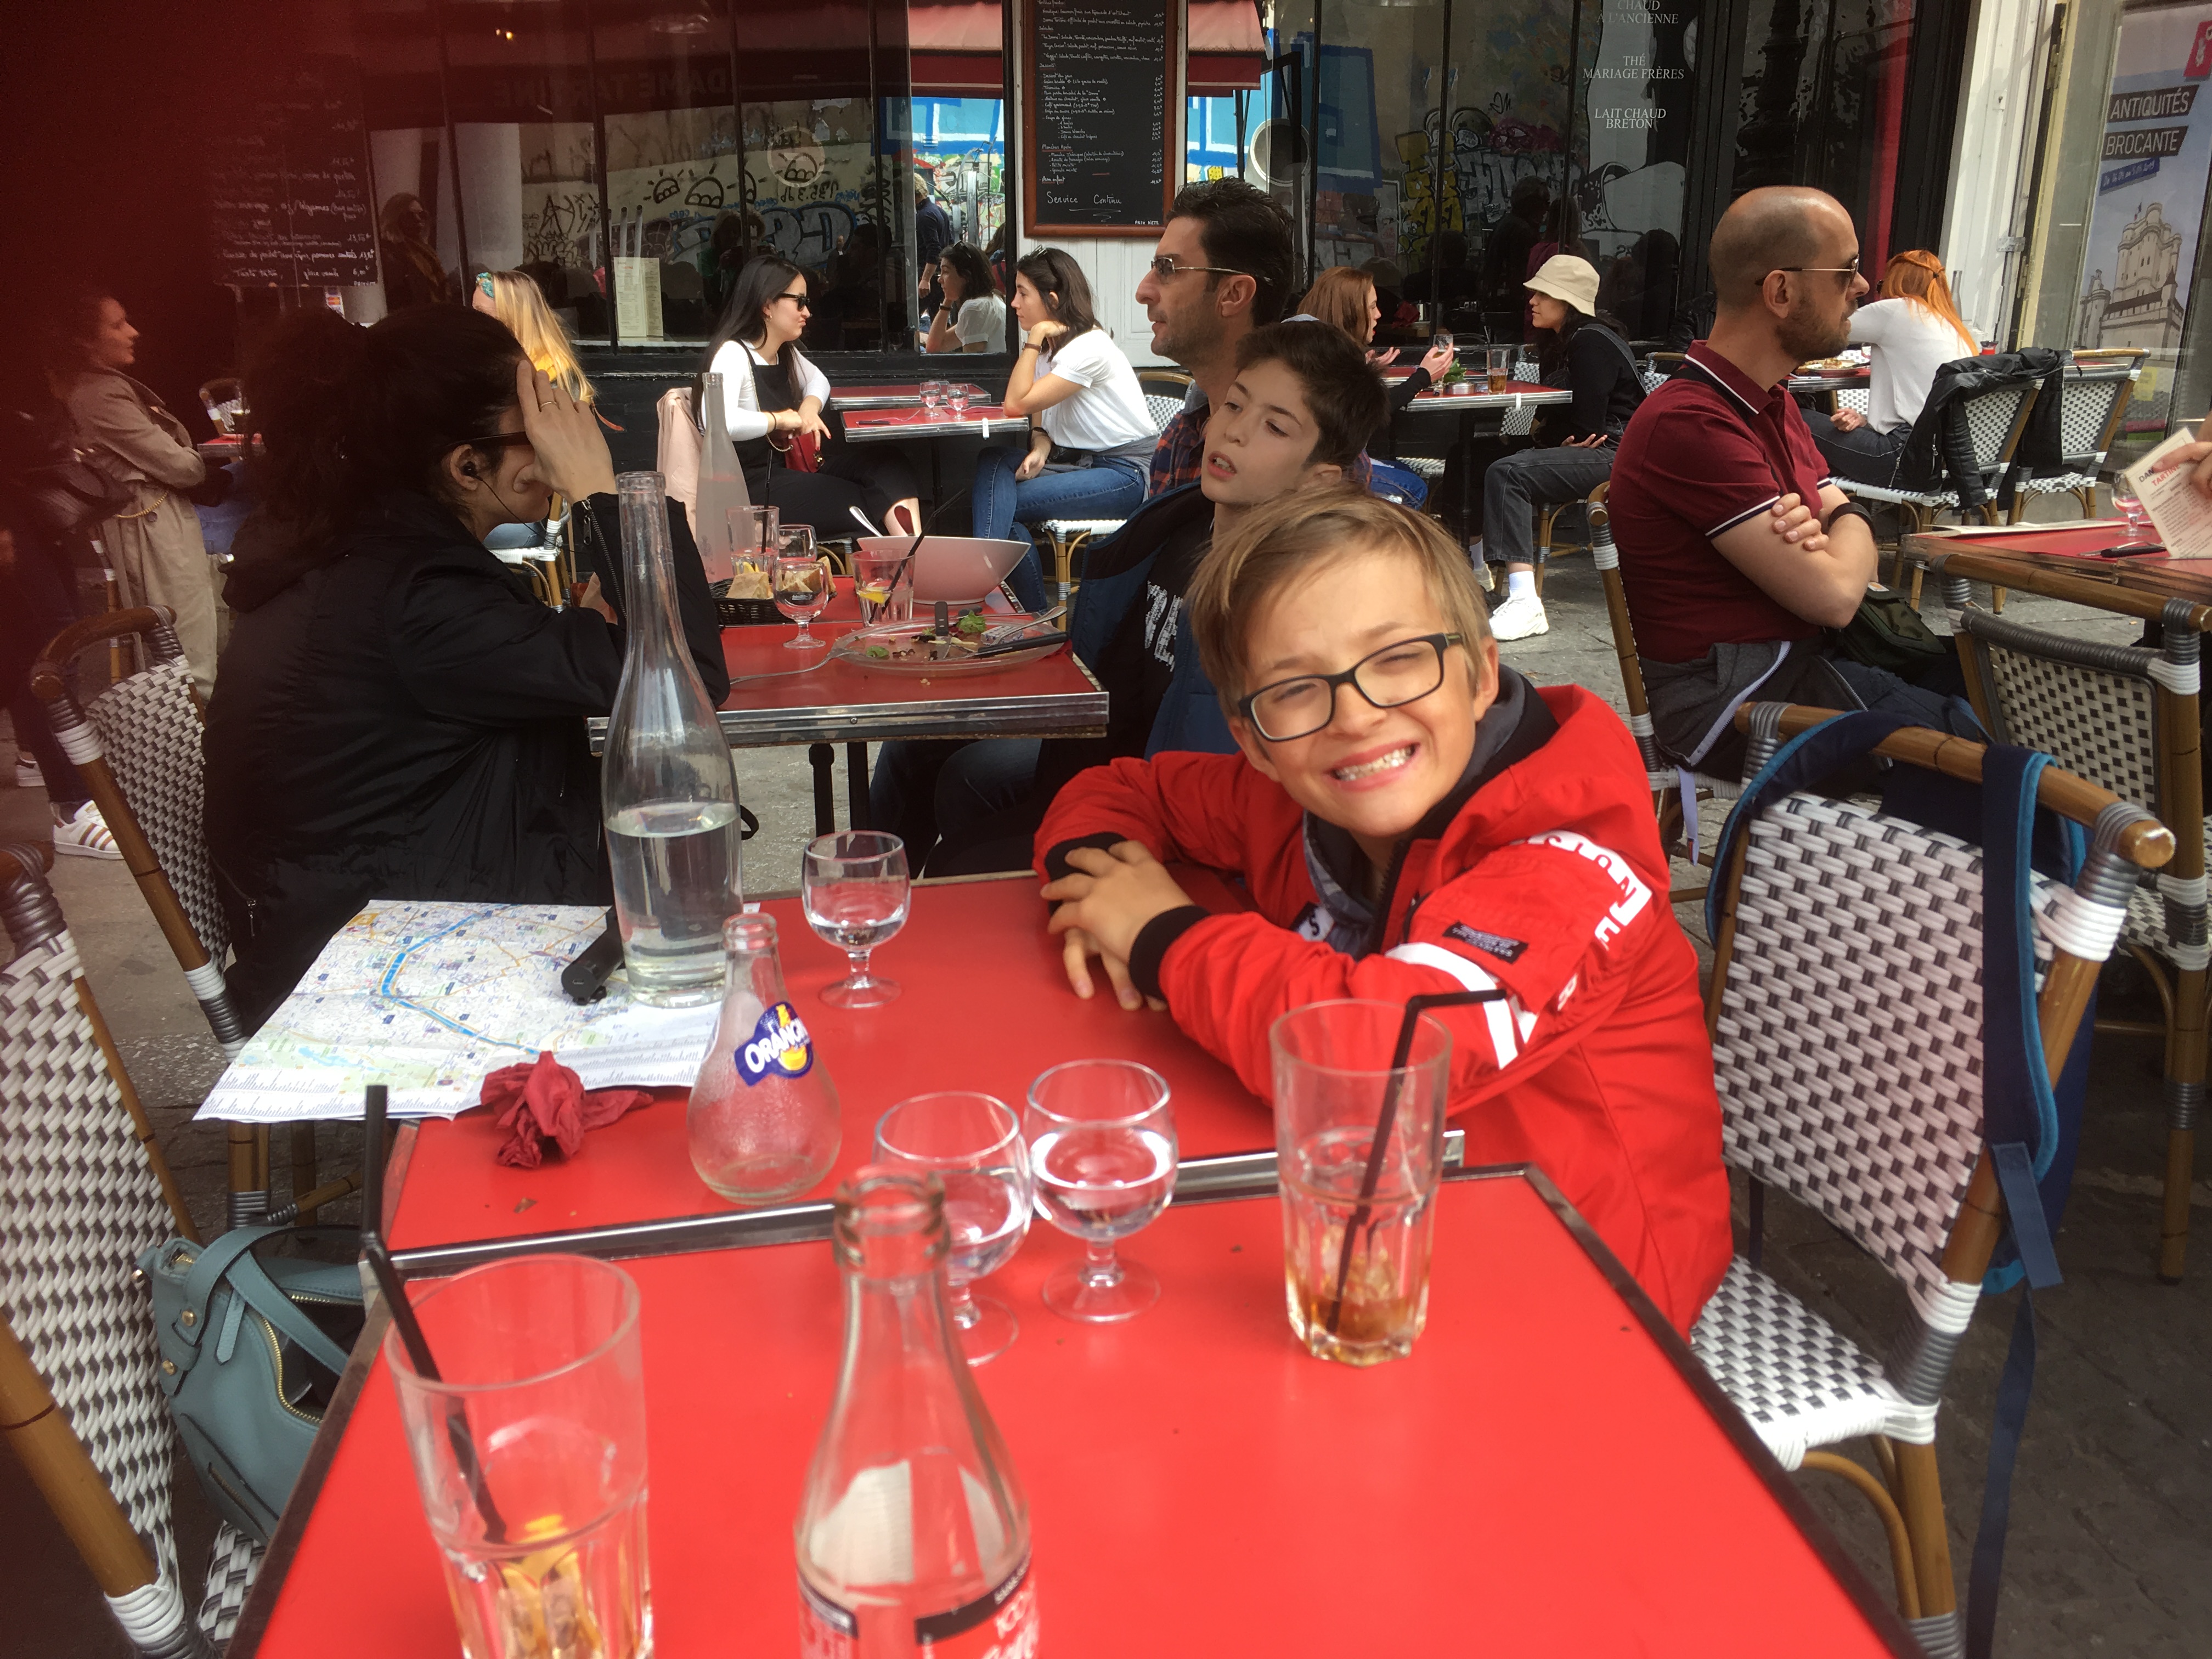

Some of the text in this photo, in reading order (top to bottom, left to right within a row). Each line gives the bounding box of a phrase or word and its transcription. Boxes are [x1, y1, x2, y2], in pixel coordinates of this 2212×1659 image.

[1617, 0, 1660, 10] CHAUD
[1609, 13, 1679, 24] L'ANCIENNE
[1623, 53, 1646, 66] THÉ
[1583, 66, 1685, 80] MARIAGE FRÈRES
[2110, 88, 2190, 120] ANTIQUITÉS
[1594, 108, 1667, 119] LAIT CHAUD
[1606, 119, 1654, 129] BRETON
[2105, 130, 2180, 156] BROCANTE
[1046, 191, 1122, 205] Service Continu
